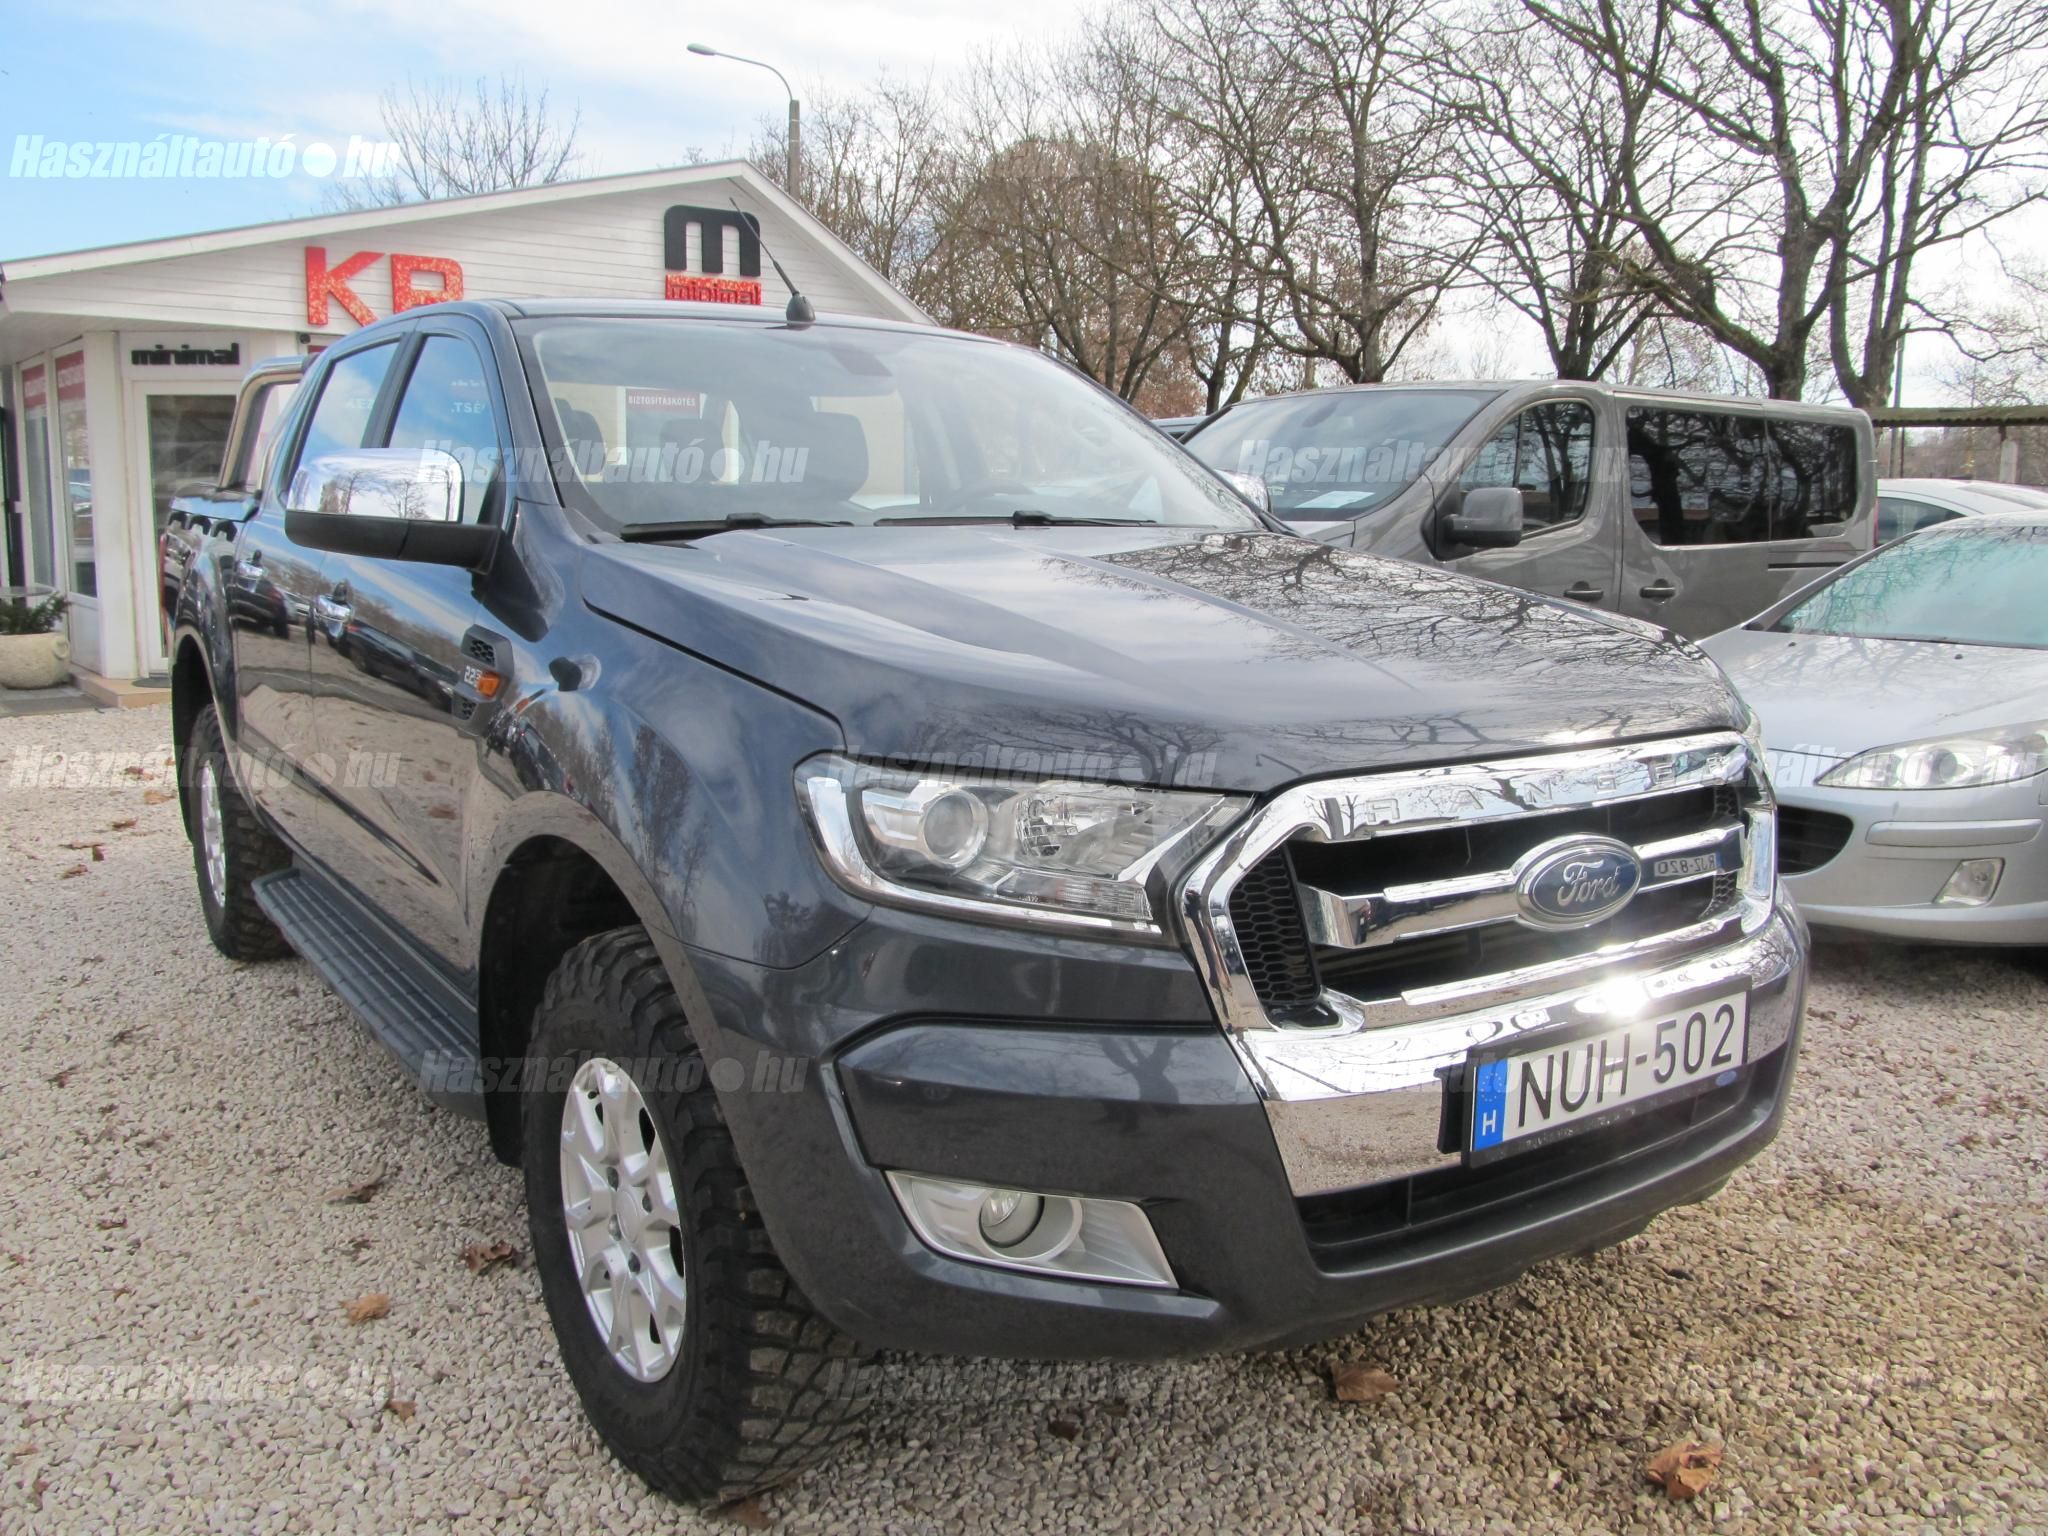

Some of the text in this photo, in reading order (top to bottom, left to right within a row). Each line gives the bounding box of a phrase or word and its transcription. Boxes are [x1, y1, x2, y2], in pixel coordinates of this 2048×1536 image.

[131, 343, 240, 365] minimal
[1366, 753, 1729, 824] RANGER
[1557, 859, 1620, 906] Ford
[1518, 1003, 1735, 1127] NUH-502
[1481, 1109, 1497, 1137] H
